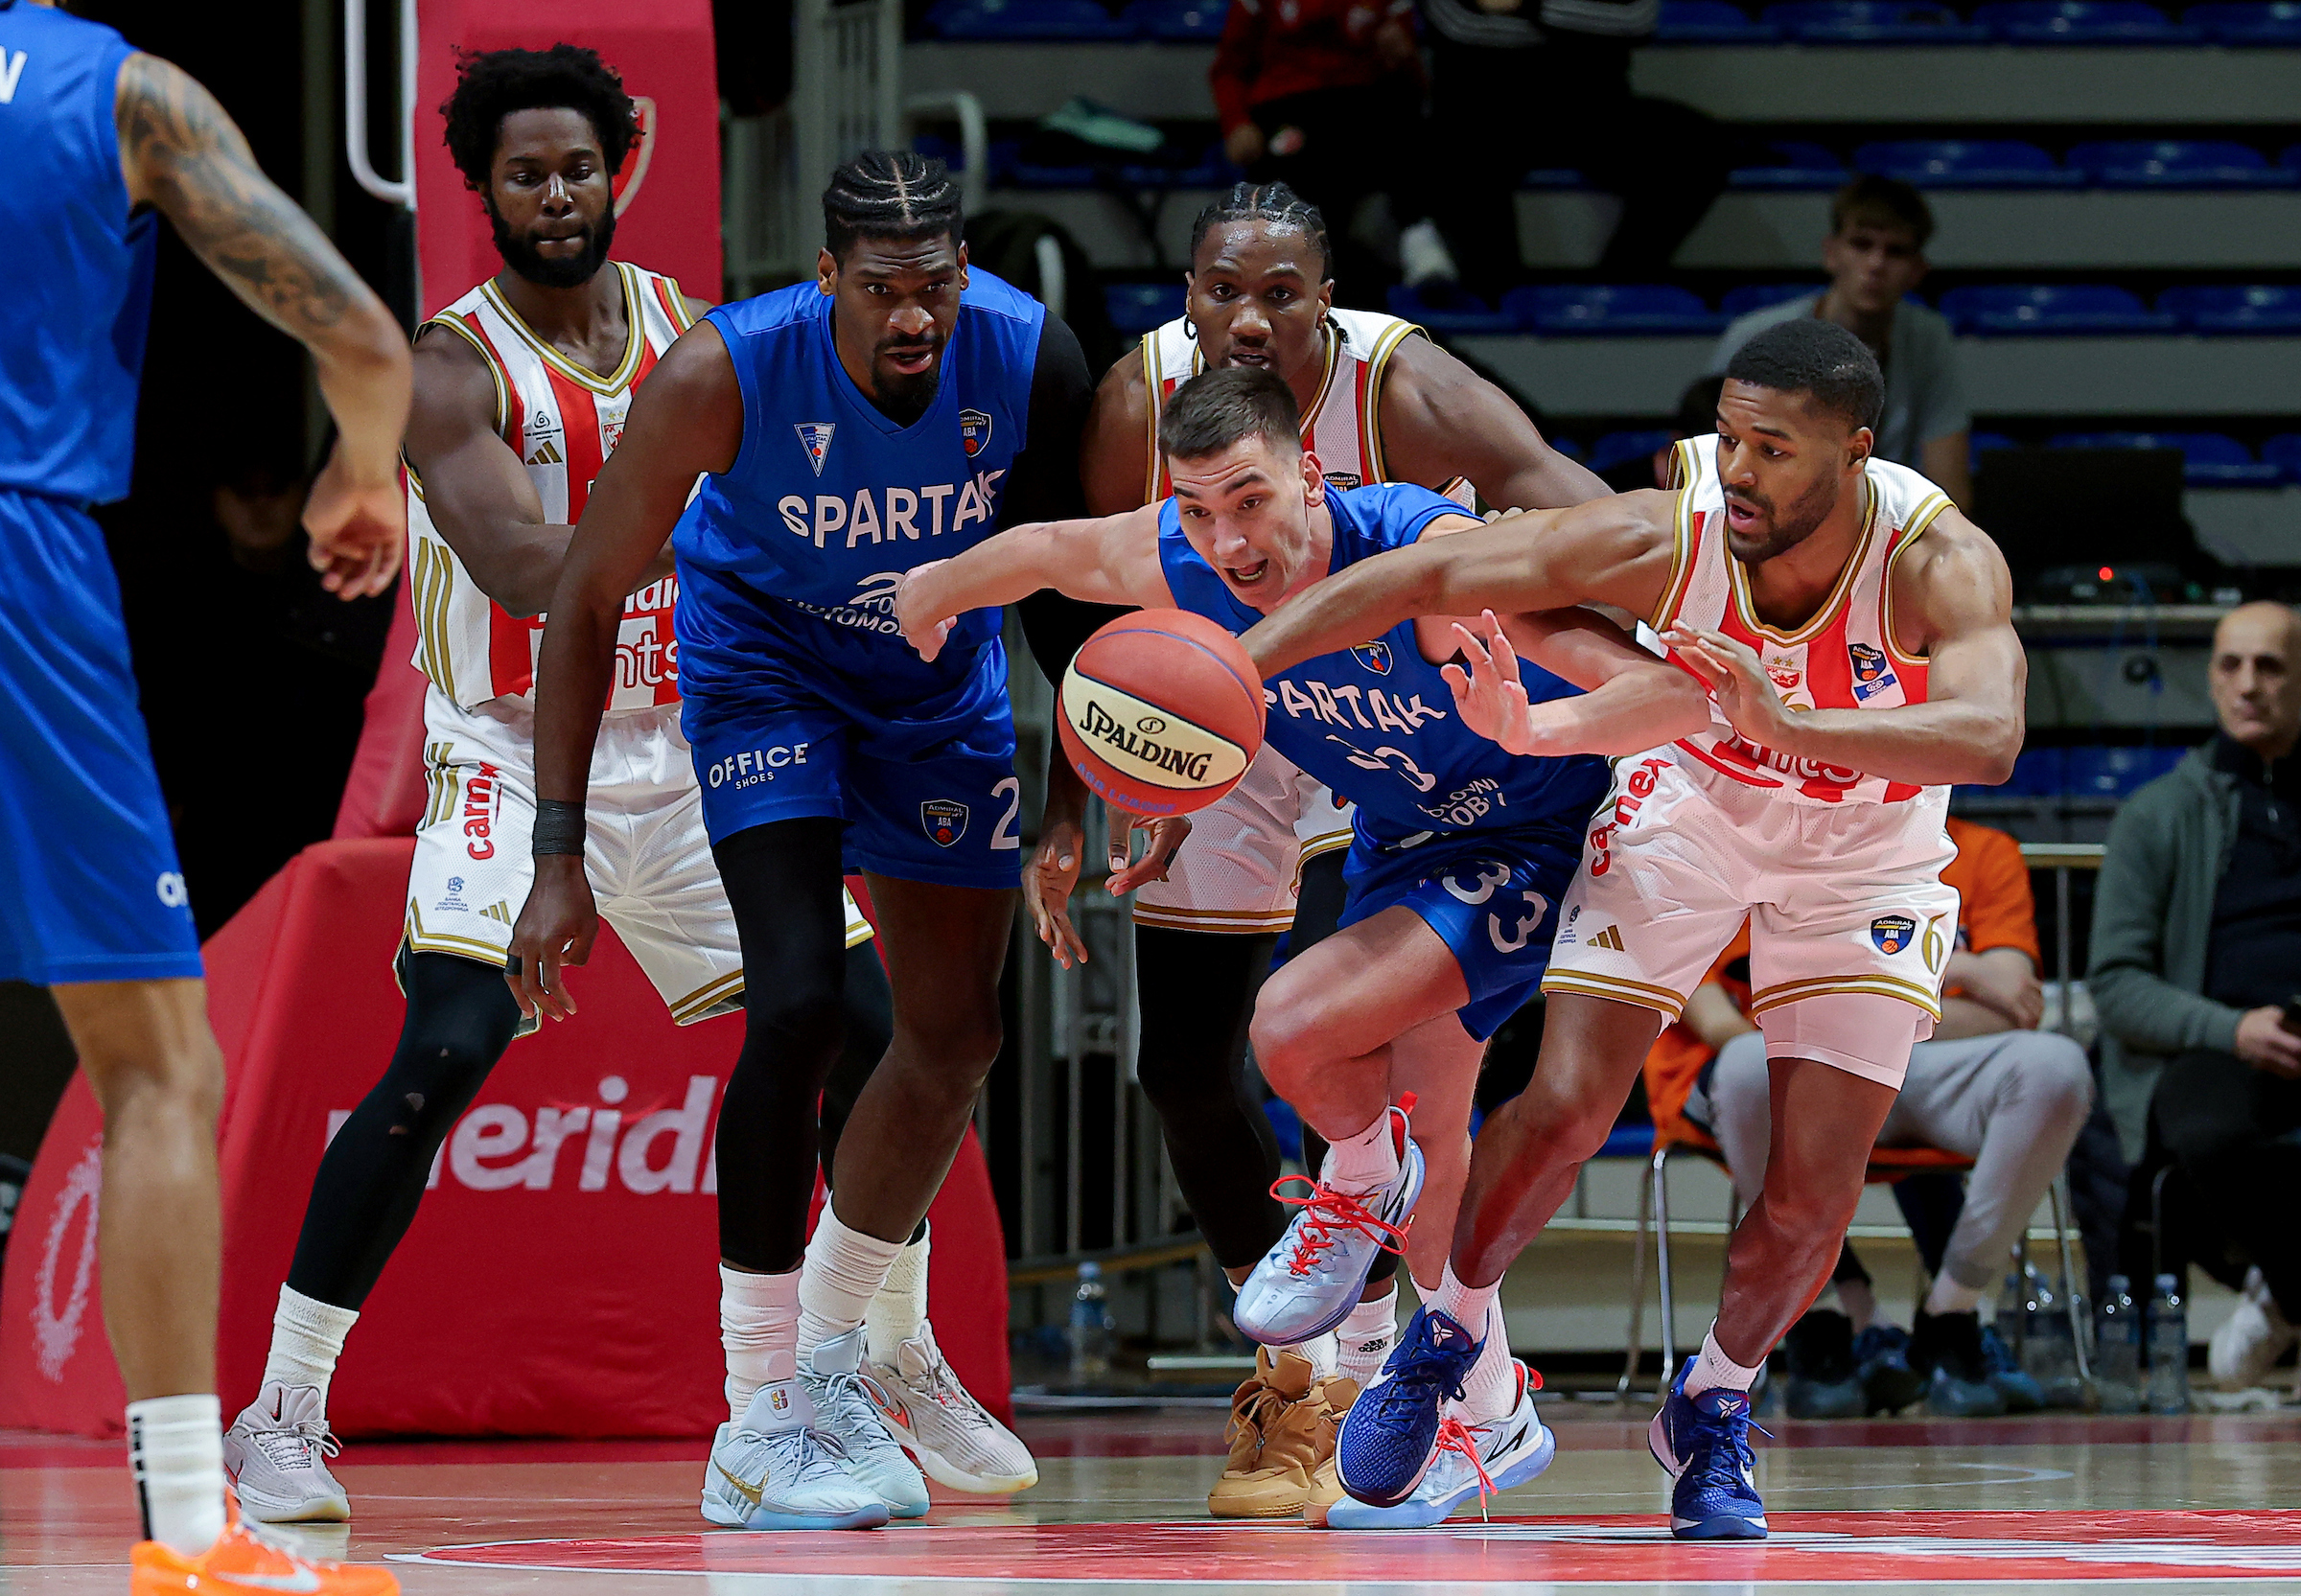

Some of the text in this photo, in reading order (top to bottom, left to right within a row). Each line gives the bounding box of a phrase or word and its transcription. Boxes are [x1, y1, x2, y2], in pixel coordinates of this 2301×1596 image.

[779, 468, 1007, 549] SPARTAK
[1080, 700, 1213, 782] SPALDING
[709, 742, 809, 790] OFFICE
[735, 771, 775, 790] SHOES
[938, 817, 952, 827] ABA
[1884, 929, 1899, 939] ABA
